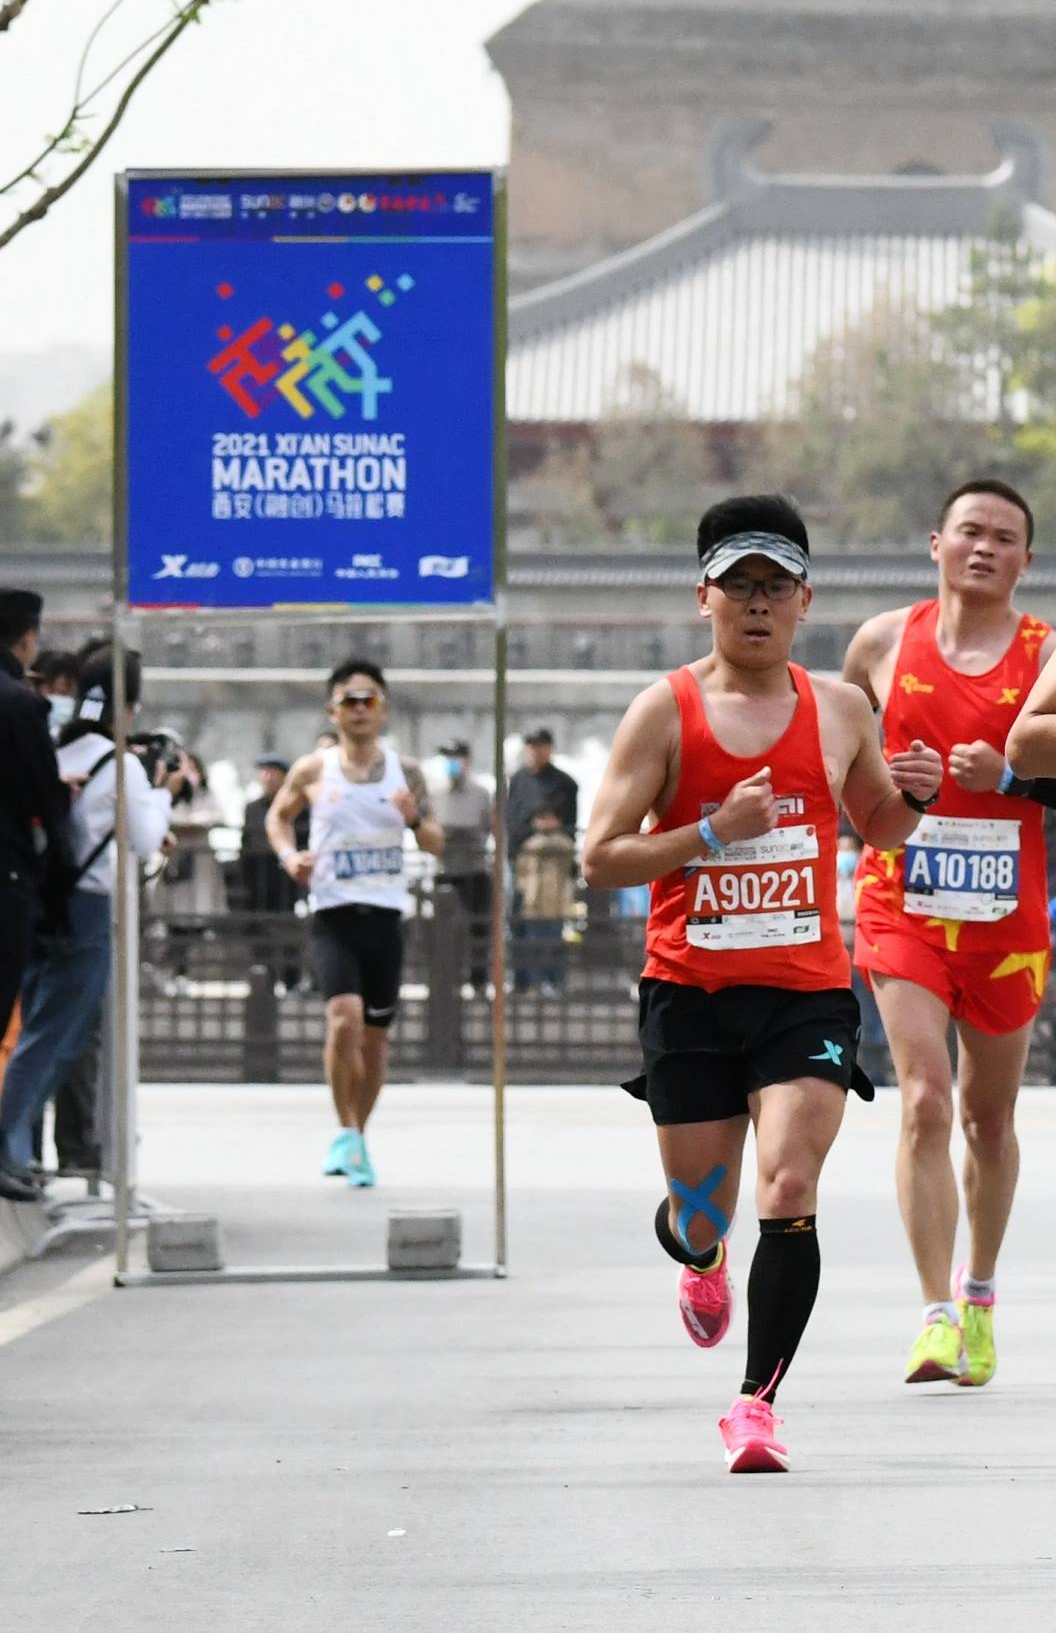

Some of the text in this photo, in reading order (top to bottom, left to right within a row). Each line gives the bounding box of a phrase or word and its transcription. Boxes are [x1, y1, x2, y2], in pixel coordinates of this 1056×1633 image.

[213, 433, 270, 456] 2021
[333, 433, 405, 456] SUNAC
[212, 457, 406, 491] MARATHON
[909, 850, 1014, 890] A10188
[693, 866, 815, 912] A90221
